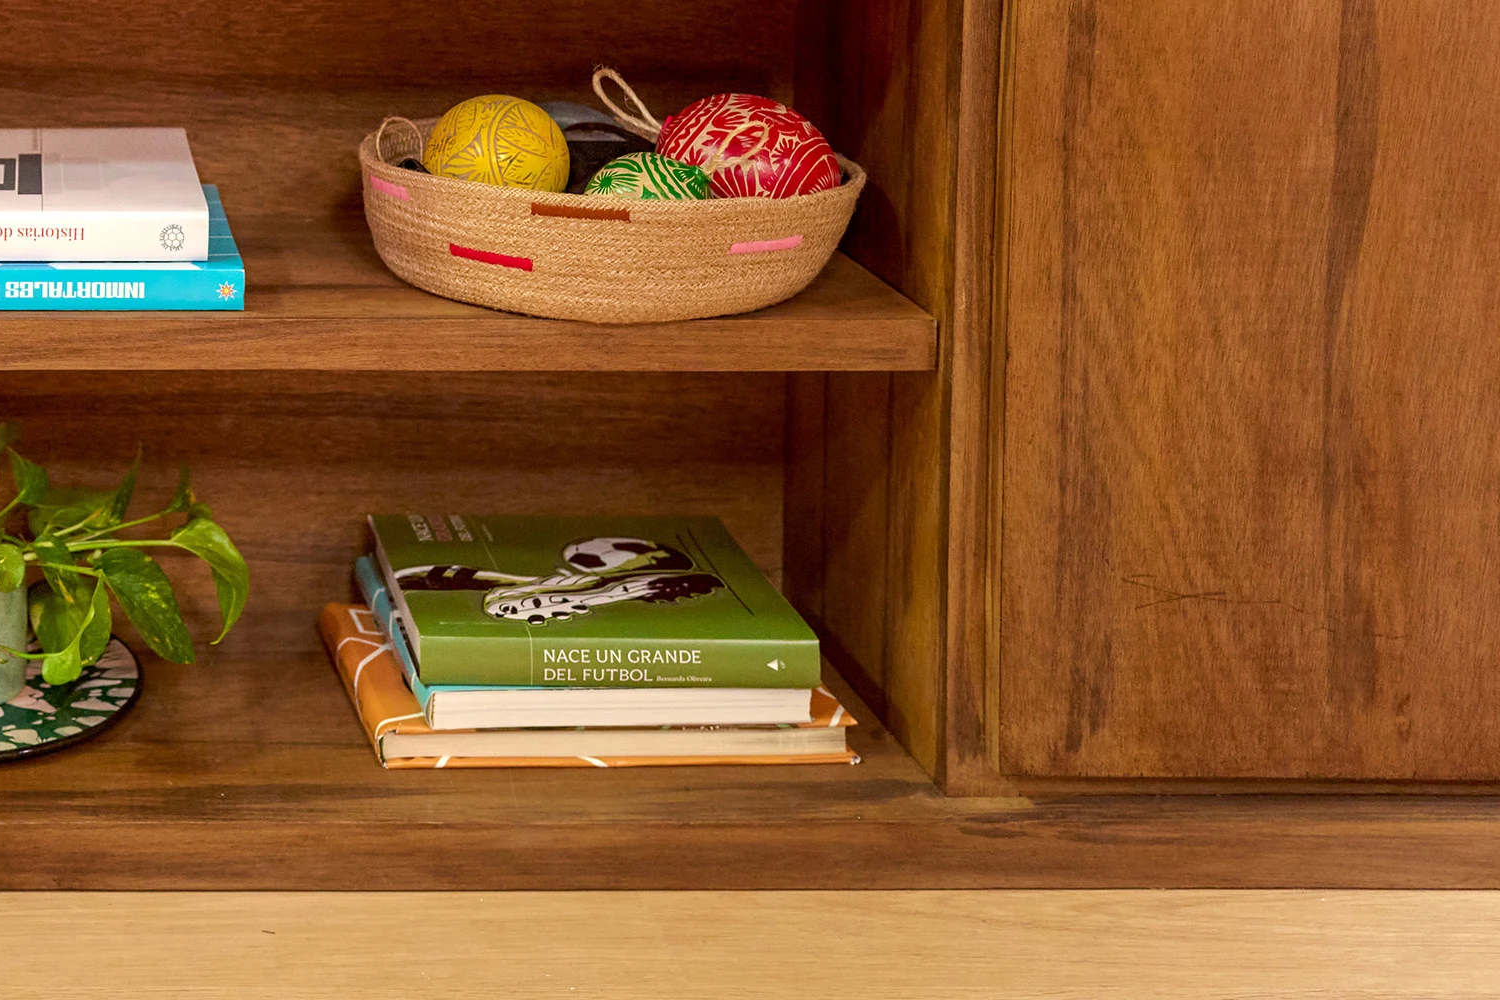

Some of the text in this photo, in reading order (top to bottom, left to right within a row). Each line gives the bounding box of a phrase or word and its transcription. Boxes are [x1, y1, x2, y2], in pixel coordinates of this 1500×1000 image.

[17, 226, 85, 241] Historias
[4, 280, 145, 299] INMORTALES
[543, 649, 702, 665] NACE UN GRANDE
[543, 668, 577, 682] DEL
[582, 668, 653, 683] FUTBOL
